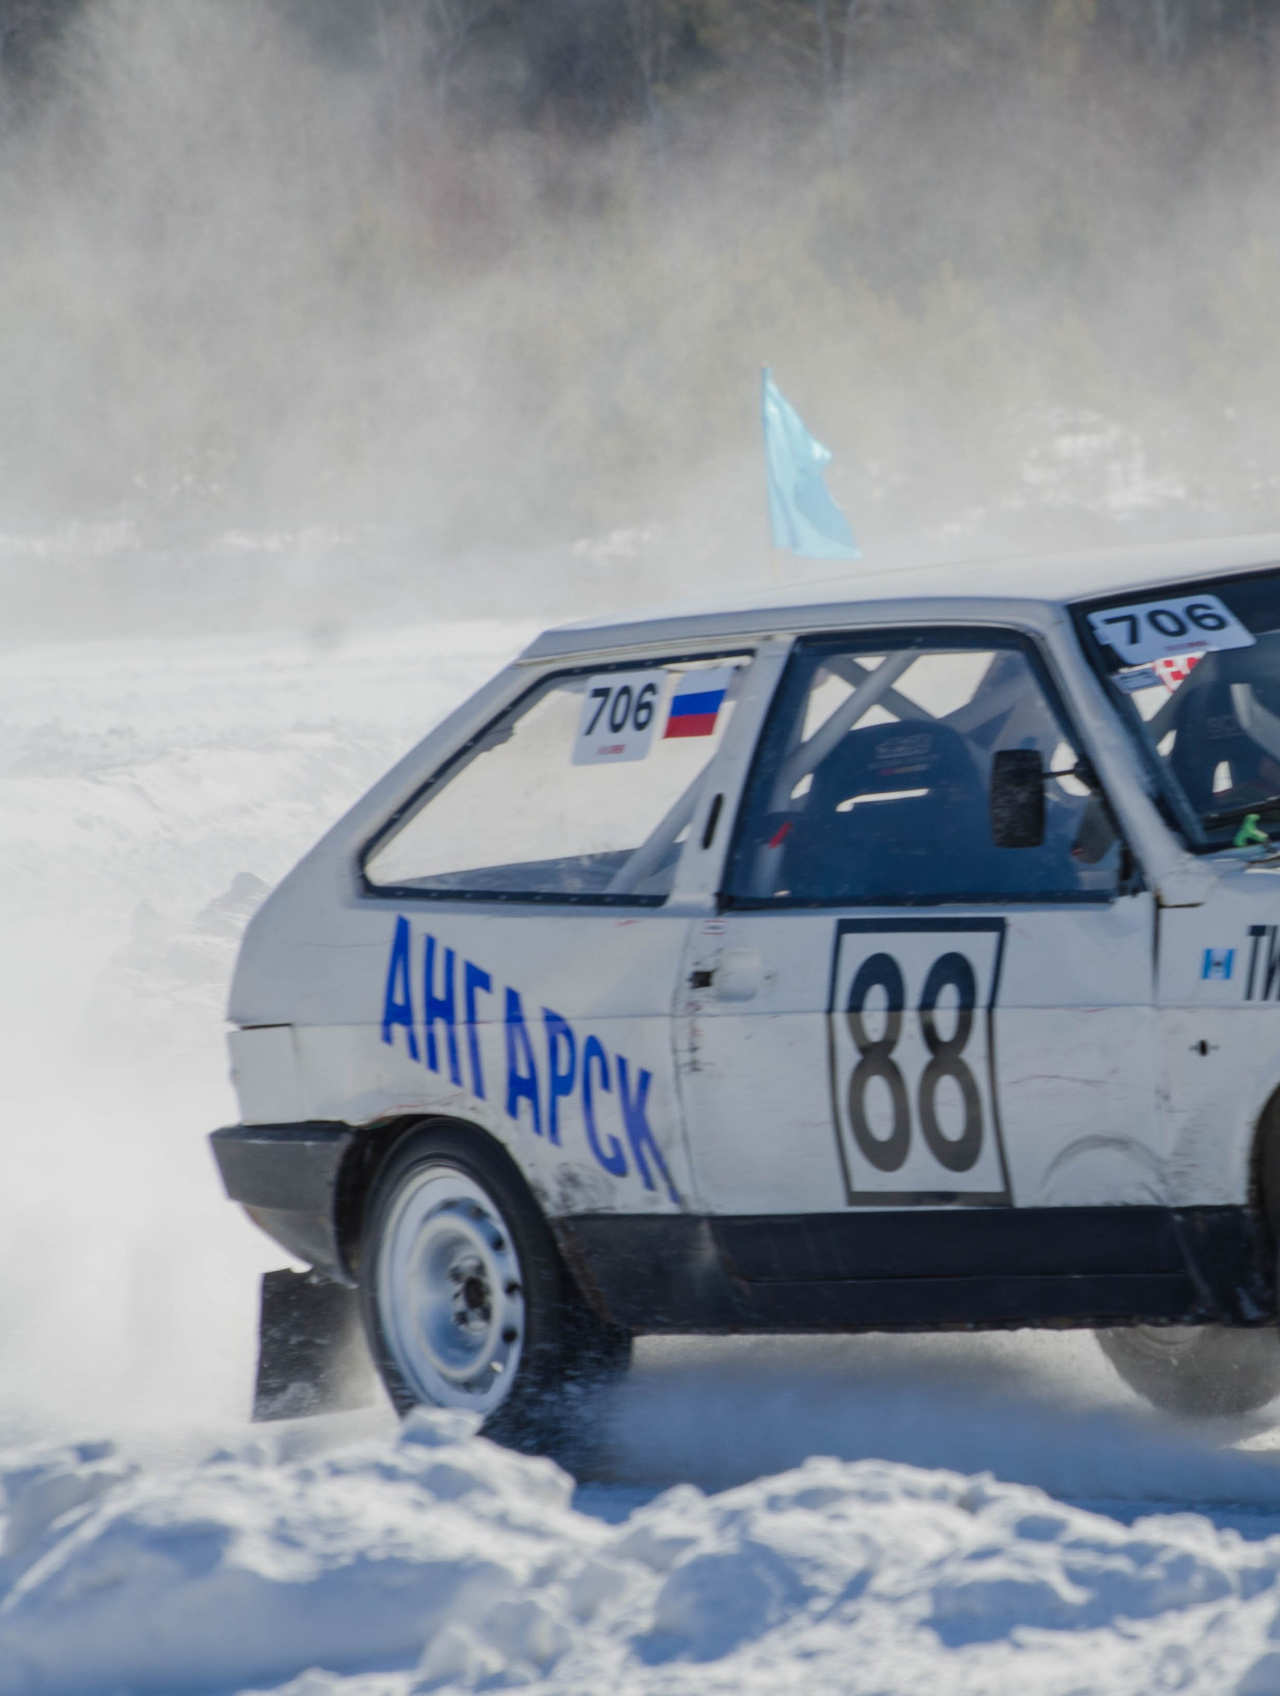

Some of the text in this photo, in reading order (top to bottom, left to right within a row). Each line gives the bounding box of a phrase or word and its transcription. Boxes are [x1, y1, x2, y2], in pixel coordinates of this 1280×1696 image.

[1103, 603, 1227, 645] 706
[584, 683, 658, 736] 706
[381, 914, 681, 1204] АНГАРСК
[846, 952, 984, 1173] 88
